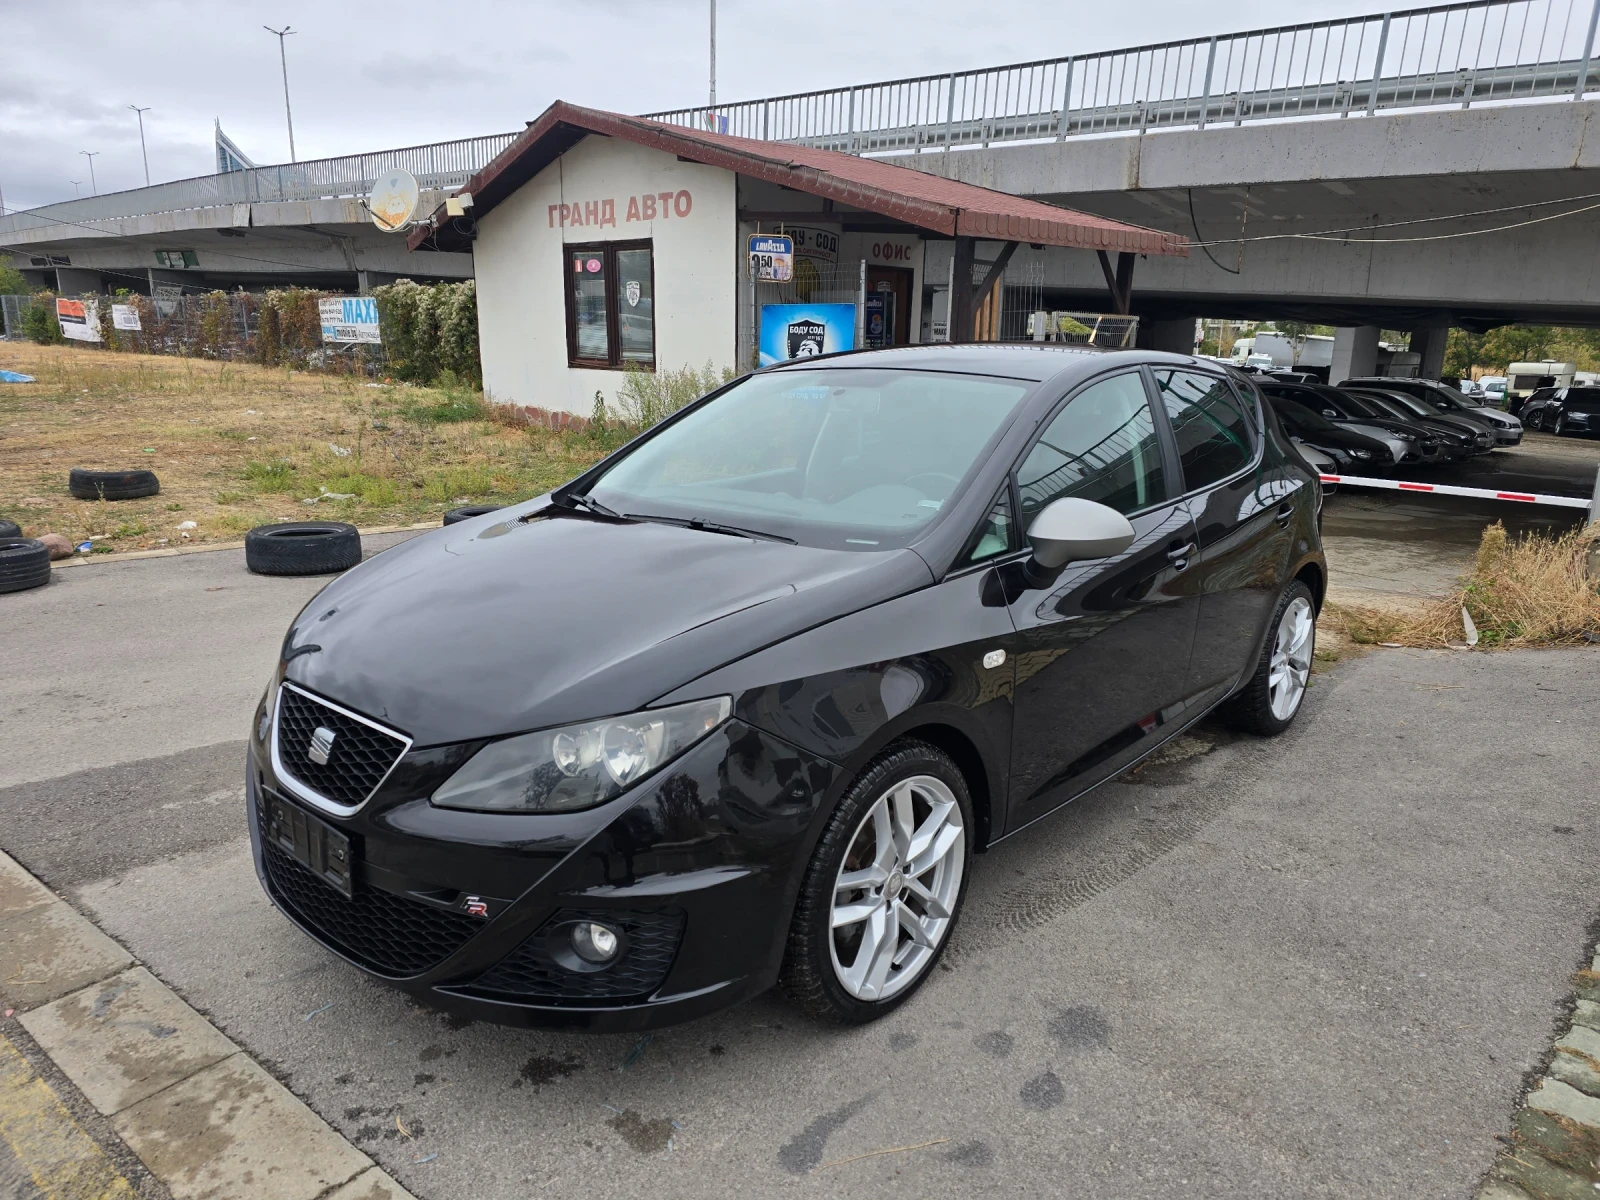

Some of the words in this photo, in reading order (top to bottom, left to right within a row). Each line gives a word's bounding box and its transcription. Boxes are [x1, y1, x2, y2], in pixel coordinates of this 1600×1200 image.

[548, 198, 616, 229] ГРАНД
[625, 189, 693, 222] АВТО
[756, 240, 785, 253] LAVAZZA
[816, 232, 836, 253] СОД
[872, 241, 911, 261] ОФИС
[789, 326, 808, 335] БОДУ
[809, 326, 824, 335] СОД
[460, 896, 488, 917] FR
